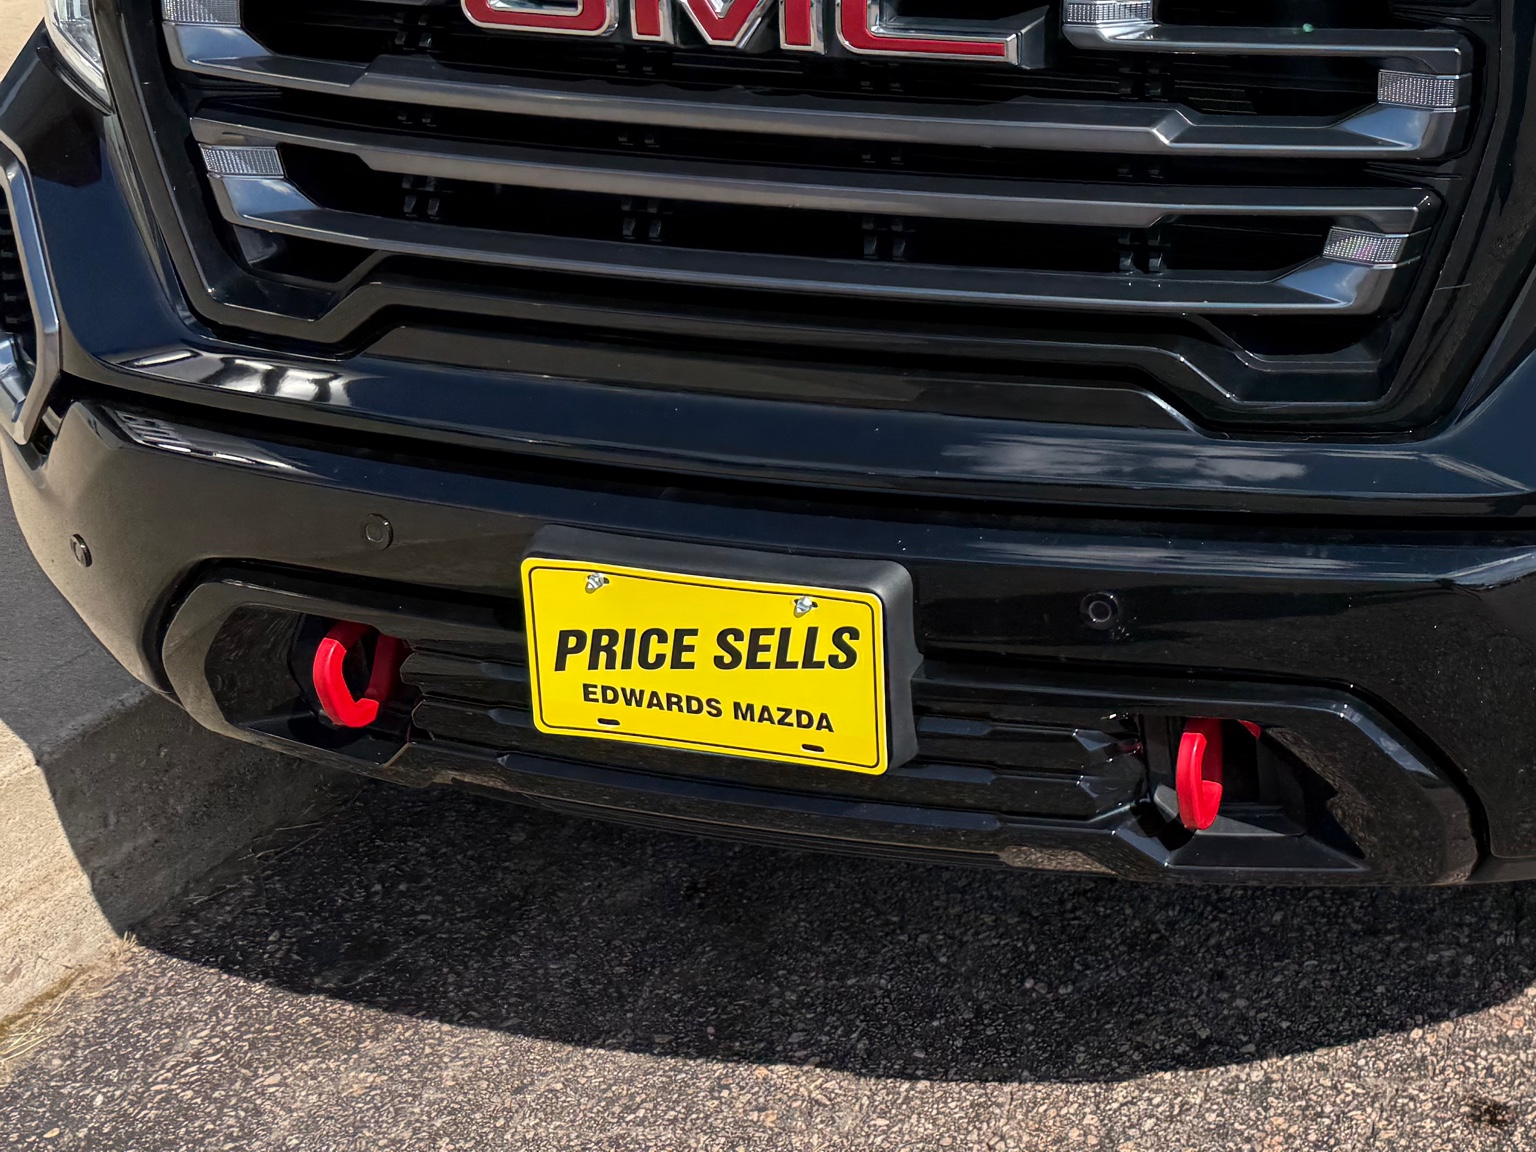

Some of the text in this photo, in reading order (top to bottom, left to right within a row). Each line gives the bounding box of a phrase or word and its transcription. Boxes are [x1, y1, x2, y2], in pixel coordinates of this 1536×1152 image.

[554, 626, 860, 672] PRICE SELLS
[582, 683, 834, 733] EDWARDS MAZDA
